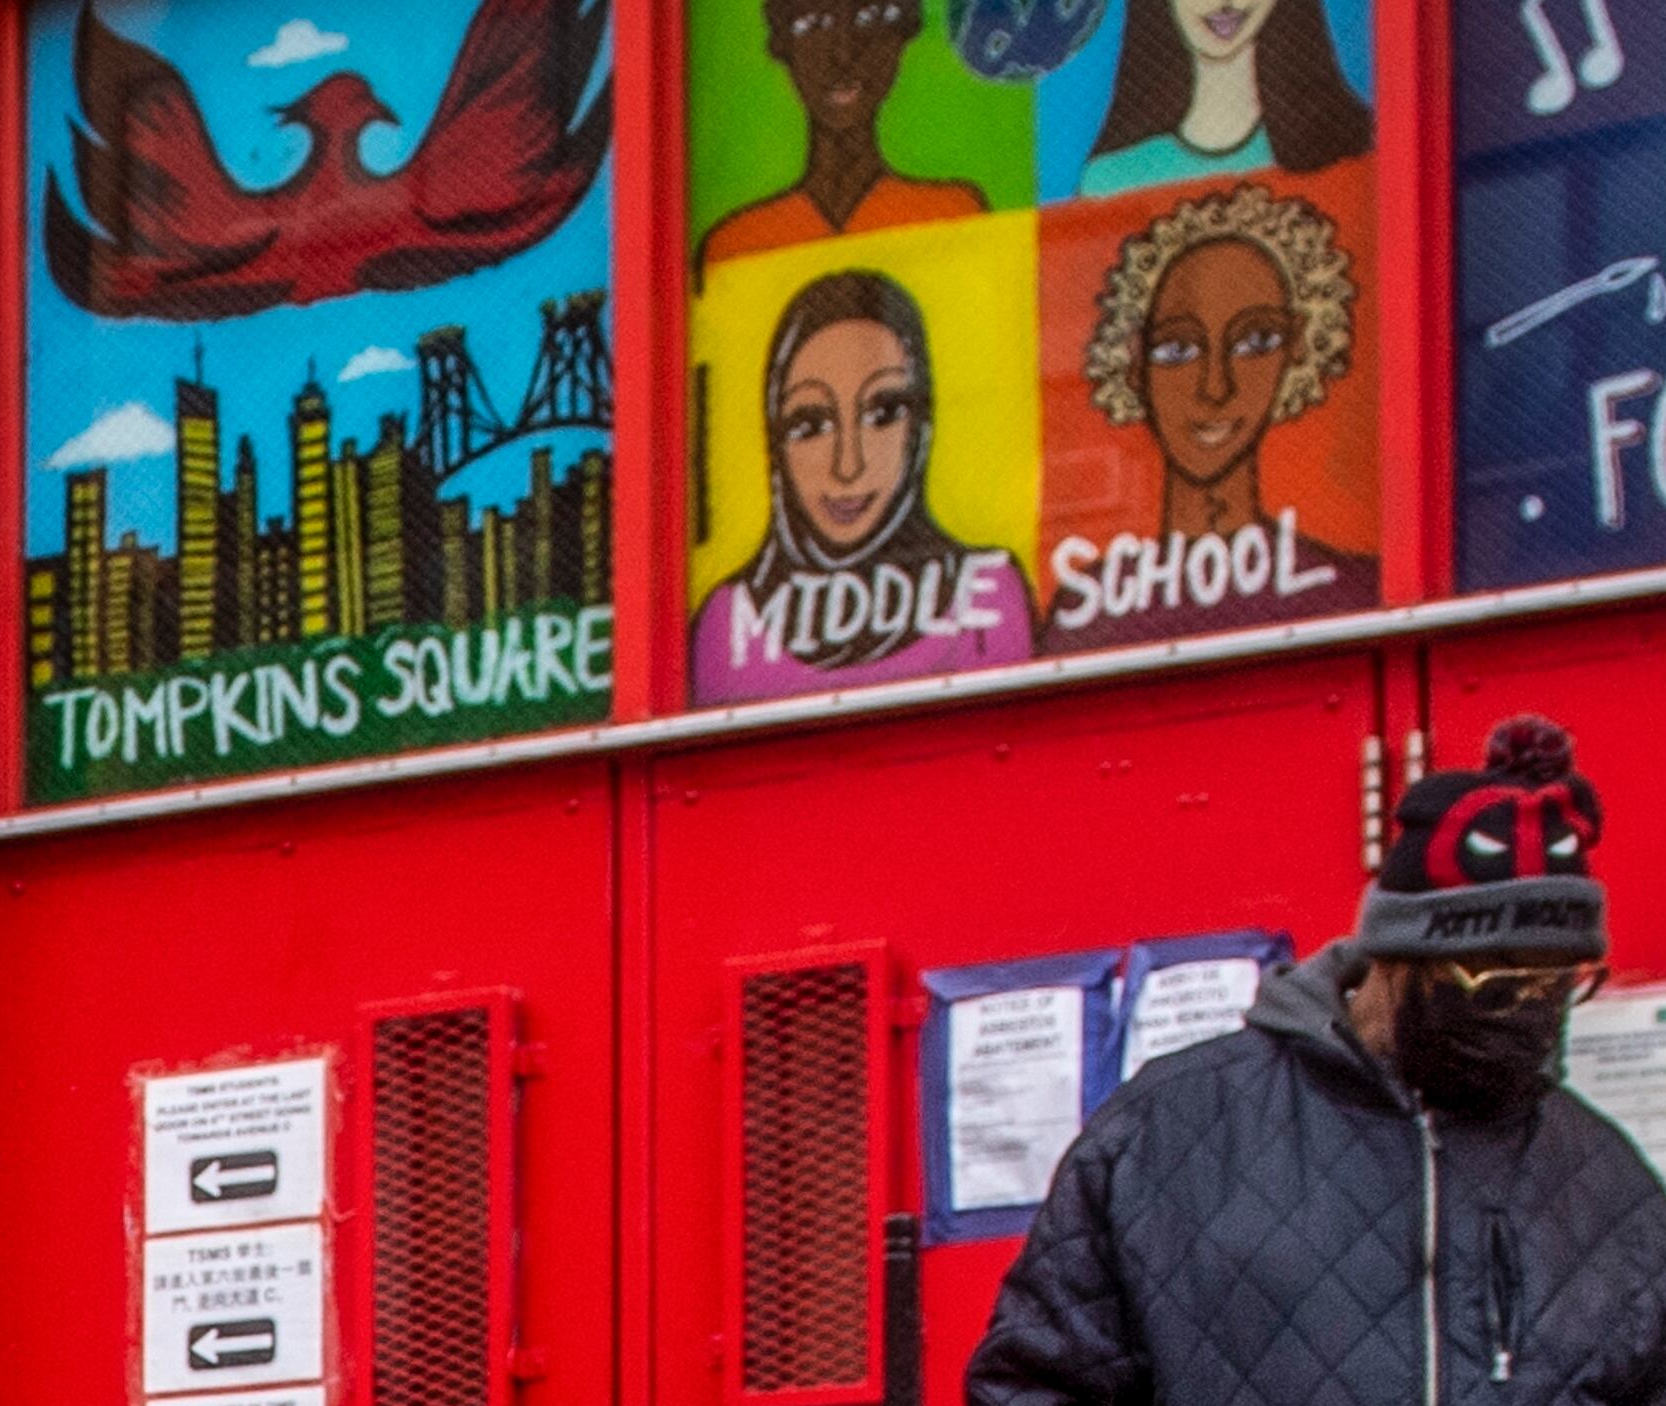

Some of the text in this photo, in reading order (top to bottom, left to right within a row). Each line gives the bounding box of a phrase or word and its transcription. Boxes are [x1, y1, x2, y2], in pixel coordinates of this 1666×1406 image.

[732, 505, 1338, 667] MIDDLE SCHOOL
[43, 603, 612, 770] TOMPKINS SQUARE
[188, 1245, 231, 1263] TSMS
